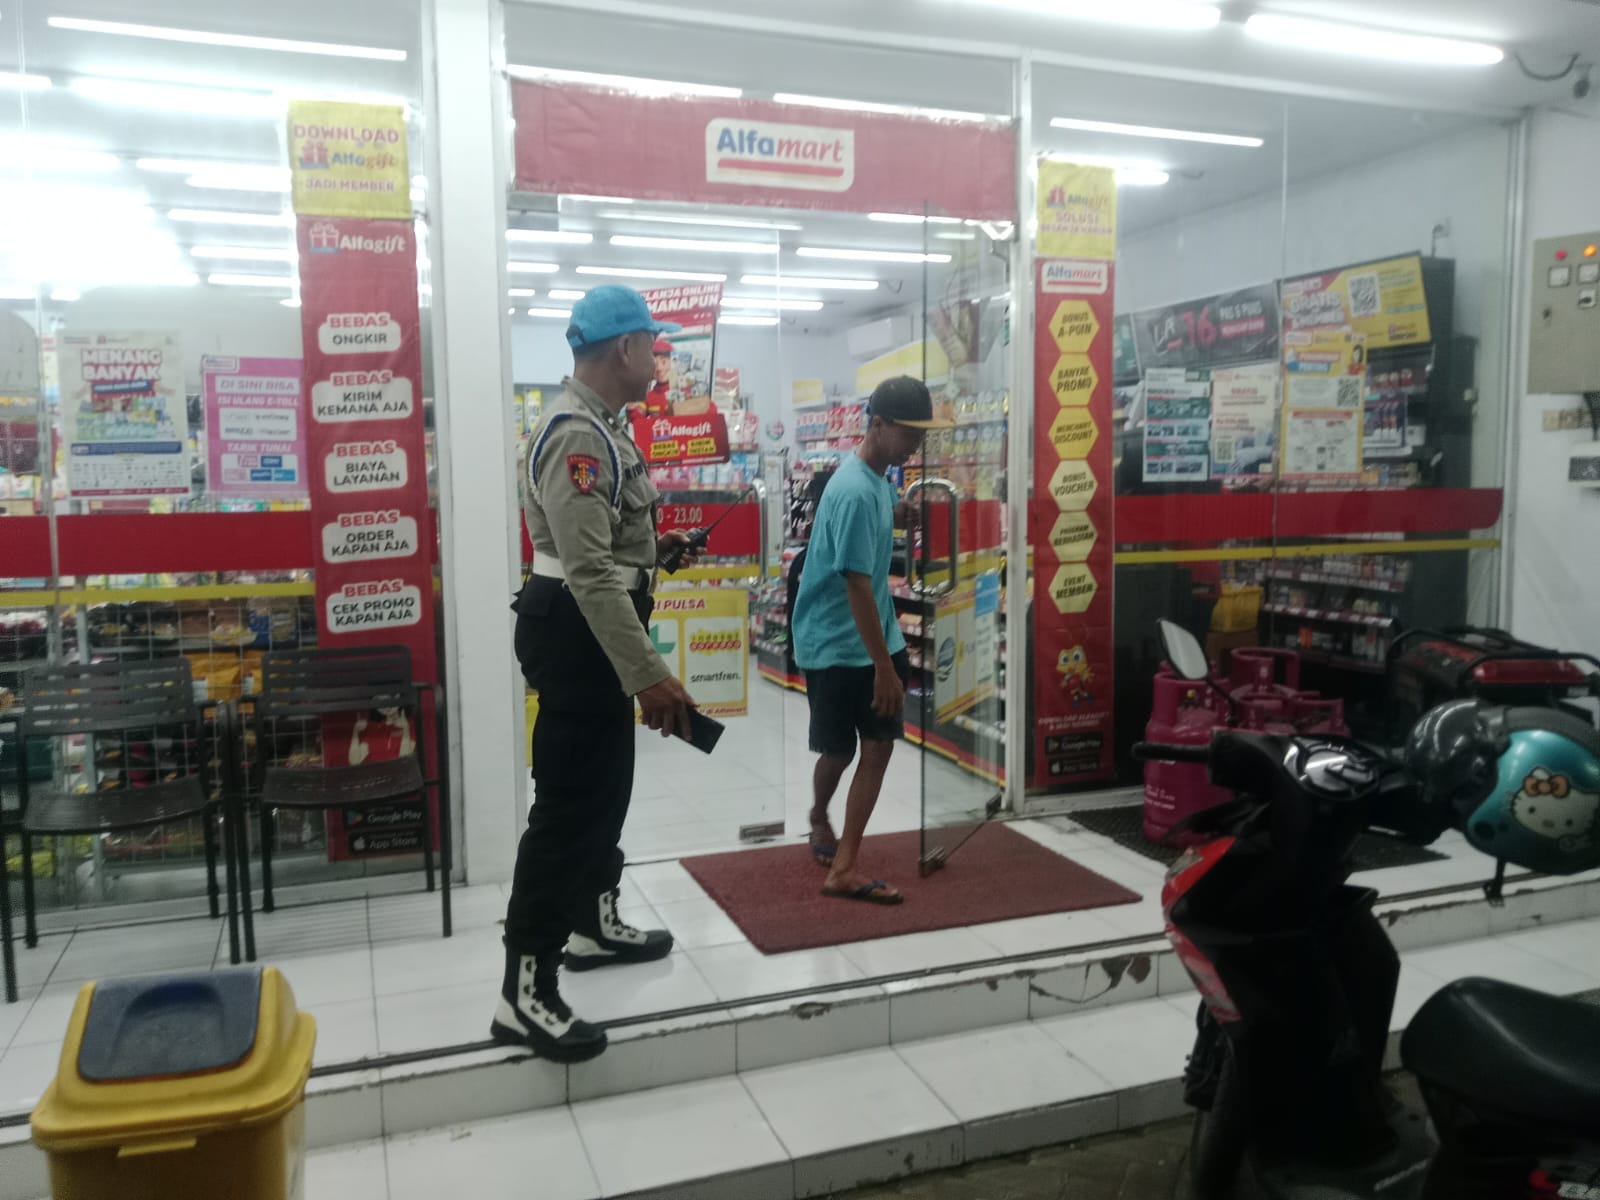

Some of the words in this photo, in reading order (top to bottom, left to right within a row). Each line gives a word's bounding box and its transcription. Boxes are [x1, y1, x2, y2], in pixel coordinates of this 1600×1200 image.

[293, 124, 400, 143] DOWNLOAD
[717, 127, 844, 162] Alfamart
[331, 152, 397, 169] Alfagift
[305, 178, 337, 191] JADI
[340, 179, 395, 192] MEMBER
[340, 234, 406, 254] Alfagift
[1047, 265, 1102, 280] Alfamart
[682, 284, 720, 296] ONLINE
[329, 314, 389, 329] BEBAS
[1183, 306, 1217, 348] 16
[332, 333, 387, 345] ONGKIR
[82, 349, 162, 364] MENANG
[82, 364, 161, 381] BANYAK
[332, 373, 392, 387] BEBAS
[1056, 377, 1092, 393] PROMO
[343, 391, 383, 403] KIRIM
[317, 403, 379, 417] KEMANA
[383, 401, 409, 413] AJA
[671, 422, 712, 437] Alfagift
[336, 442, 396, 457] BEBAS
[346, 461, 388, 473] BIAYA
[333, 471, 401, 487] LAYANAN
[1055, 480, 1095, 496] VOUCHER
[340, 511, 400, 528] BEBAS
[673, 506, 703, 524] 23.00
[346, 529, 394, 543] ORDER
[331, 542, 380, 556] KAPAN
[384, 540, 410, 552] AJA
[344, 580, 403, 598] BEBAS
[332, 602, 359, 615] CEK
[363, 597, 415, 610] PROMO
[663, 598, 705, 610] PULSA
[335, 612, 383, 627] KAPAN
[388, 609, 414, 621] AJA
